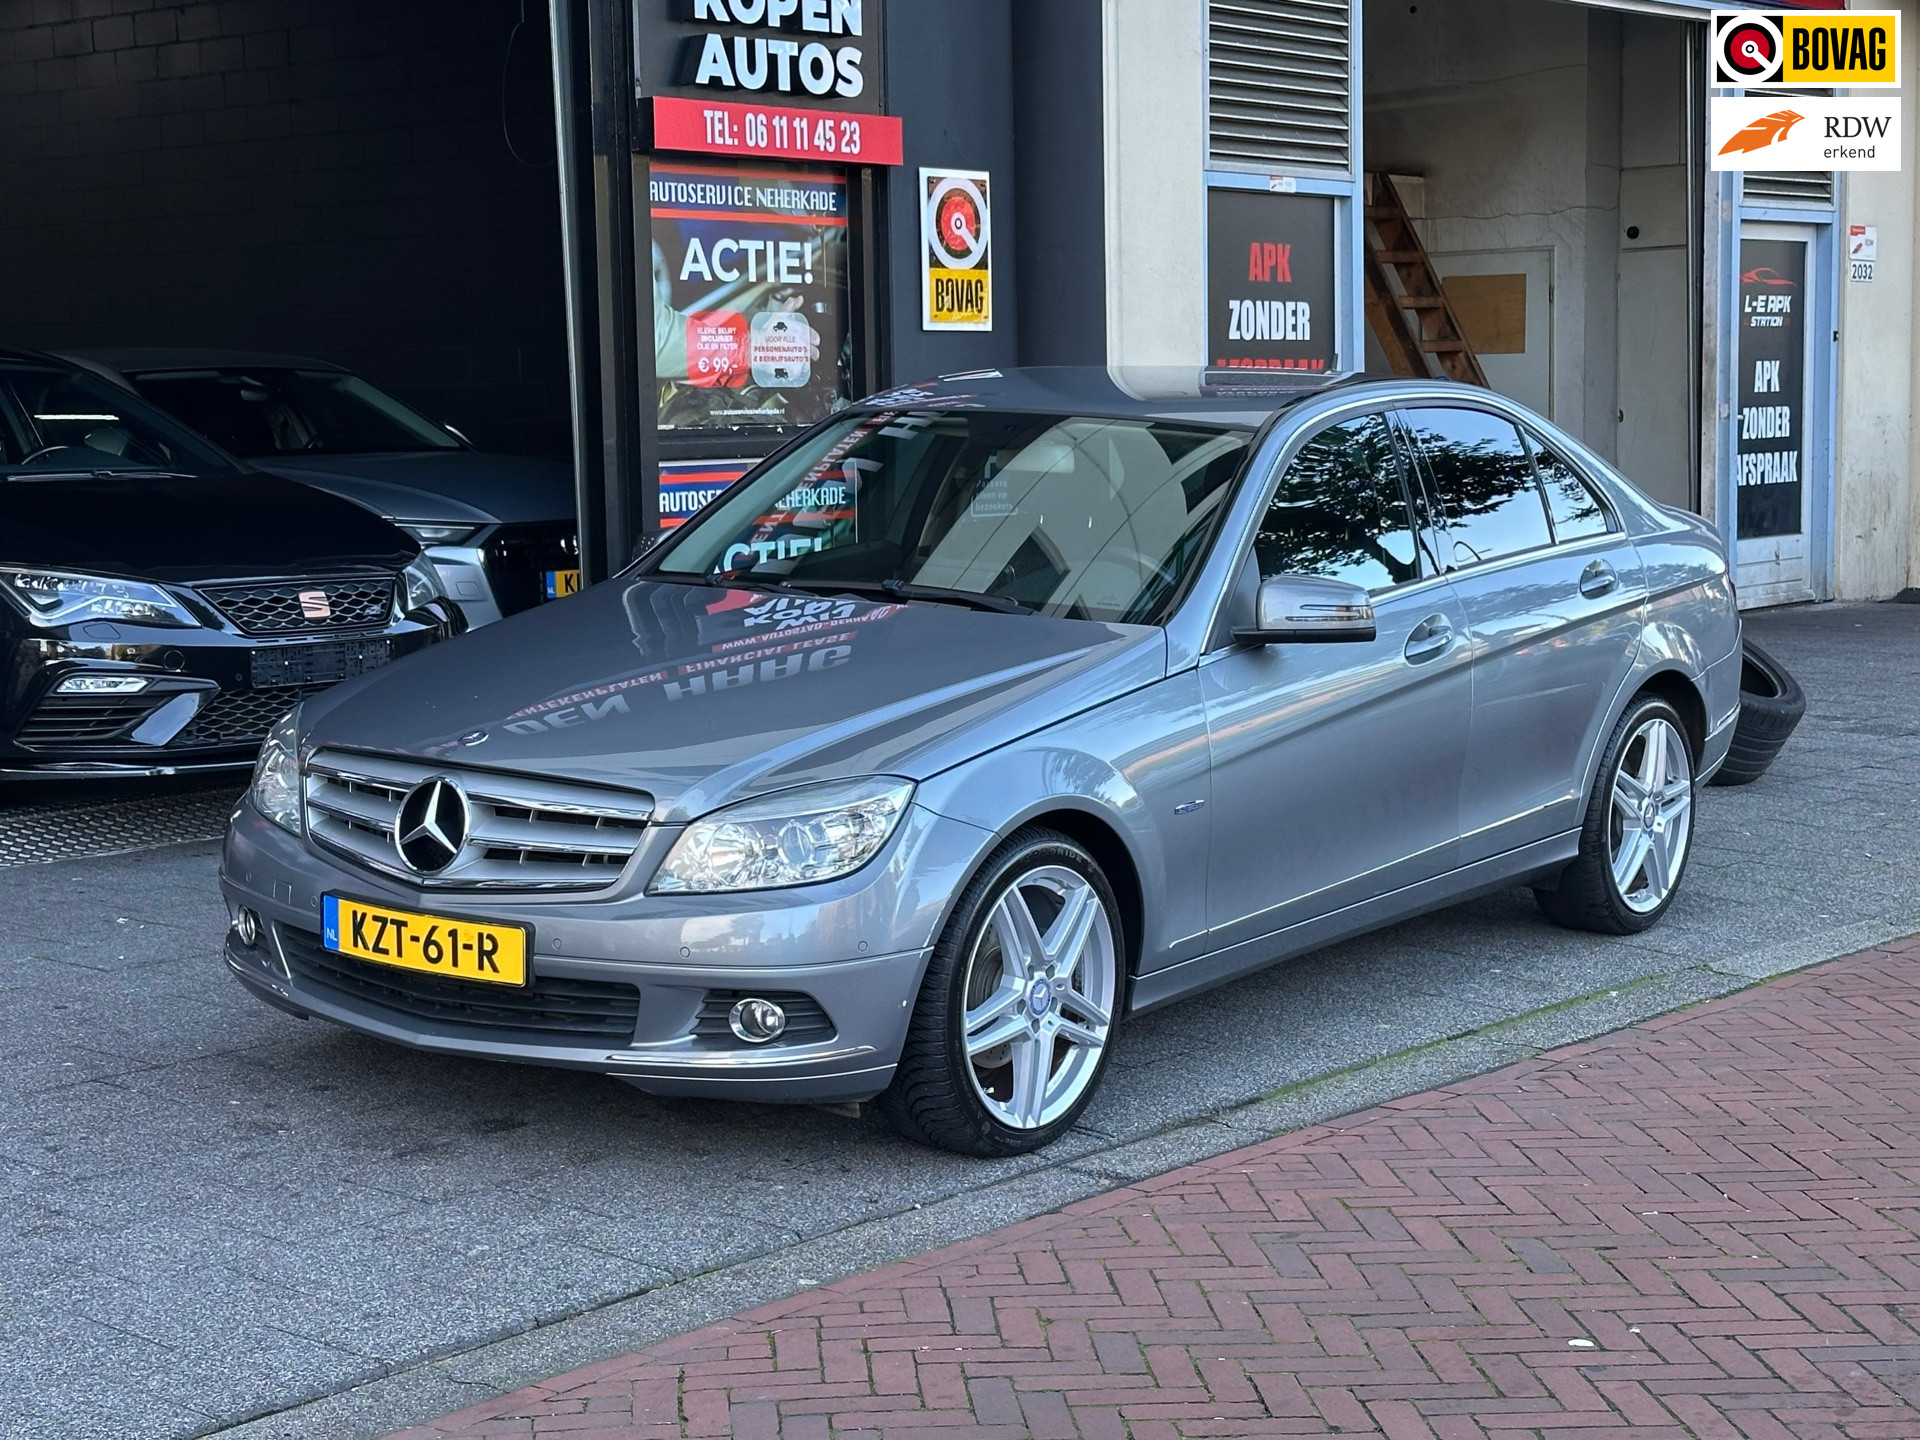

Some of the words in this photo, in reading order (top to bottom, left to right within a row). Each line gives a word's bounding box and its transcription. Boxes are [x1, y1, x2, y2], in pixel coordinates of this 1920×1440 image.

[695, 33, 864, 98] AUTOS
[703, 109, 738, 145] TEL:
[745, 112, 767, 148] 06
[772, 115, 788, 149] 11
[793, 117, 808, 150] 11
[814, 119, 836, 153] 45
[840, 120, 861, 155] 23
[650, 181, 752, 207] AUTOSERVICE
[756, 187, 837, 211] NEHERKADE
[679, 238, 813, 285] ACTIE!
[1248, 242, 1292, 282] APK
[1852, 263, 1873, 280] 2032
[935, 278, 984, 313] BOVAG
[1767, 295, 1791, 313] APK
[1228, 299, 1310, 341] ZONDER
[1750, 316, 1783, 327] STATION
[1754, 360, 1780, 393] APK
[1742, 405, 1790, 440] ZONDER
[1737, 450, 1798, 486] AFSPRAAK
[564, 573, 579, 593] K
[326, 927, 338, 941] NL
[352, 910, 500, 974] KZT-61-R
